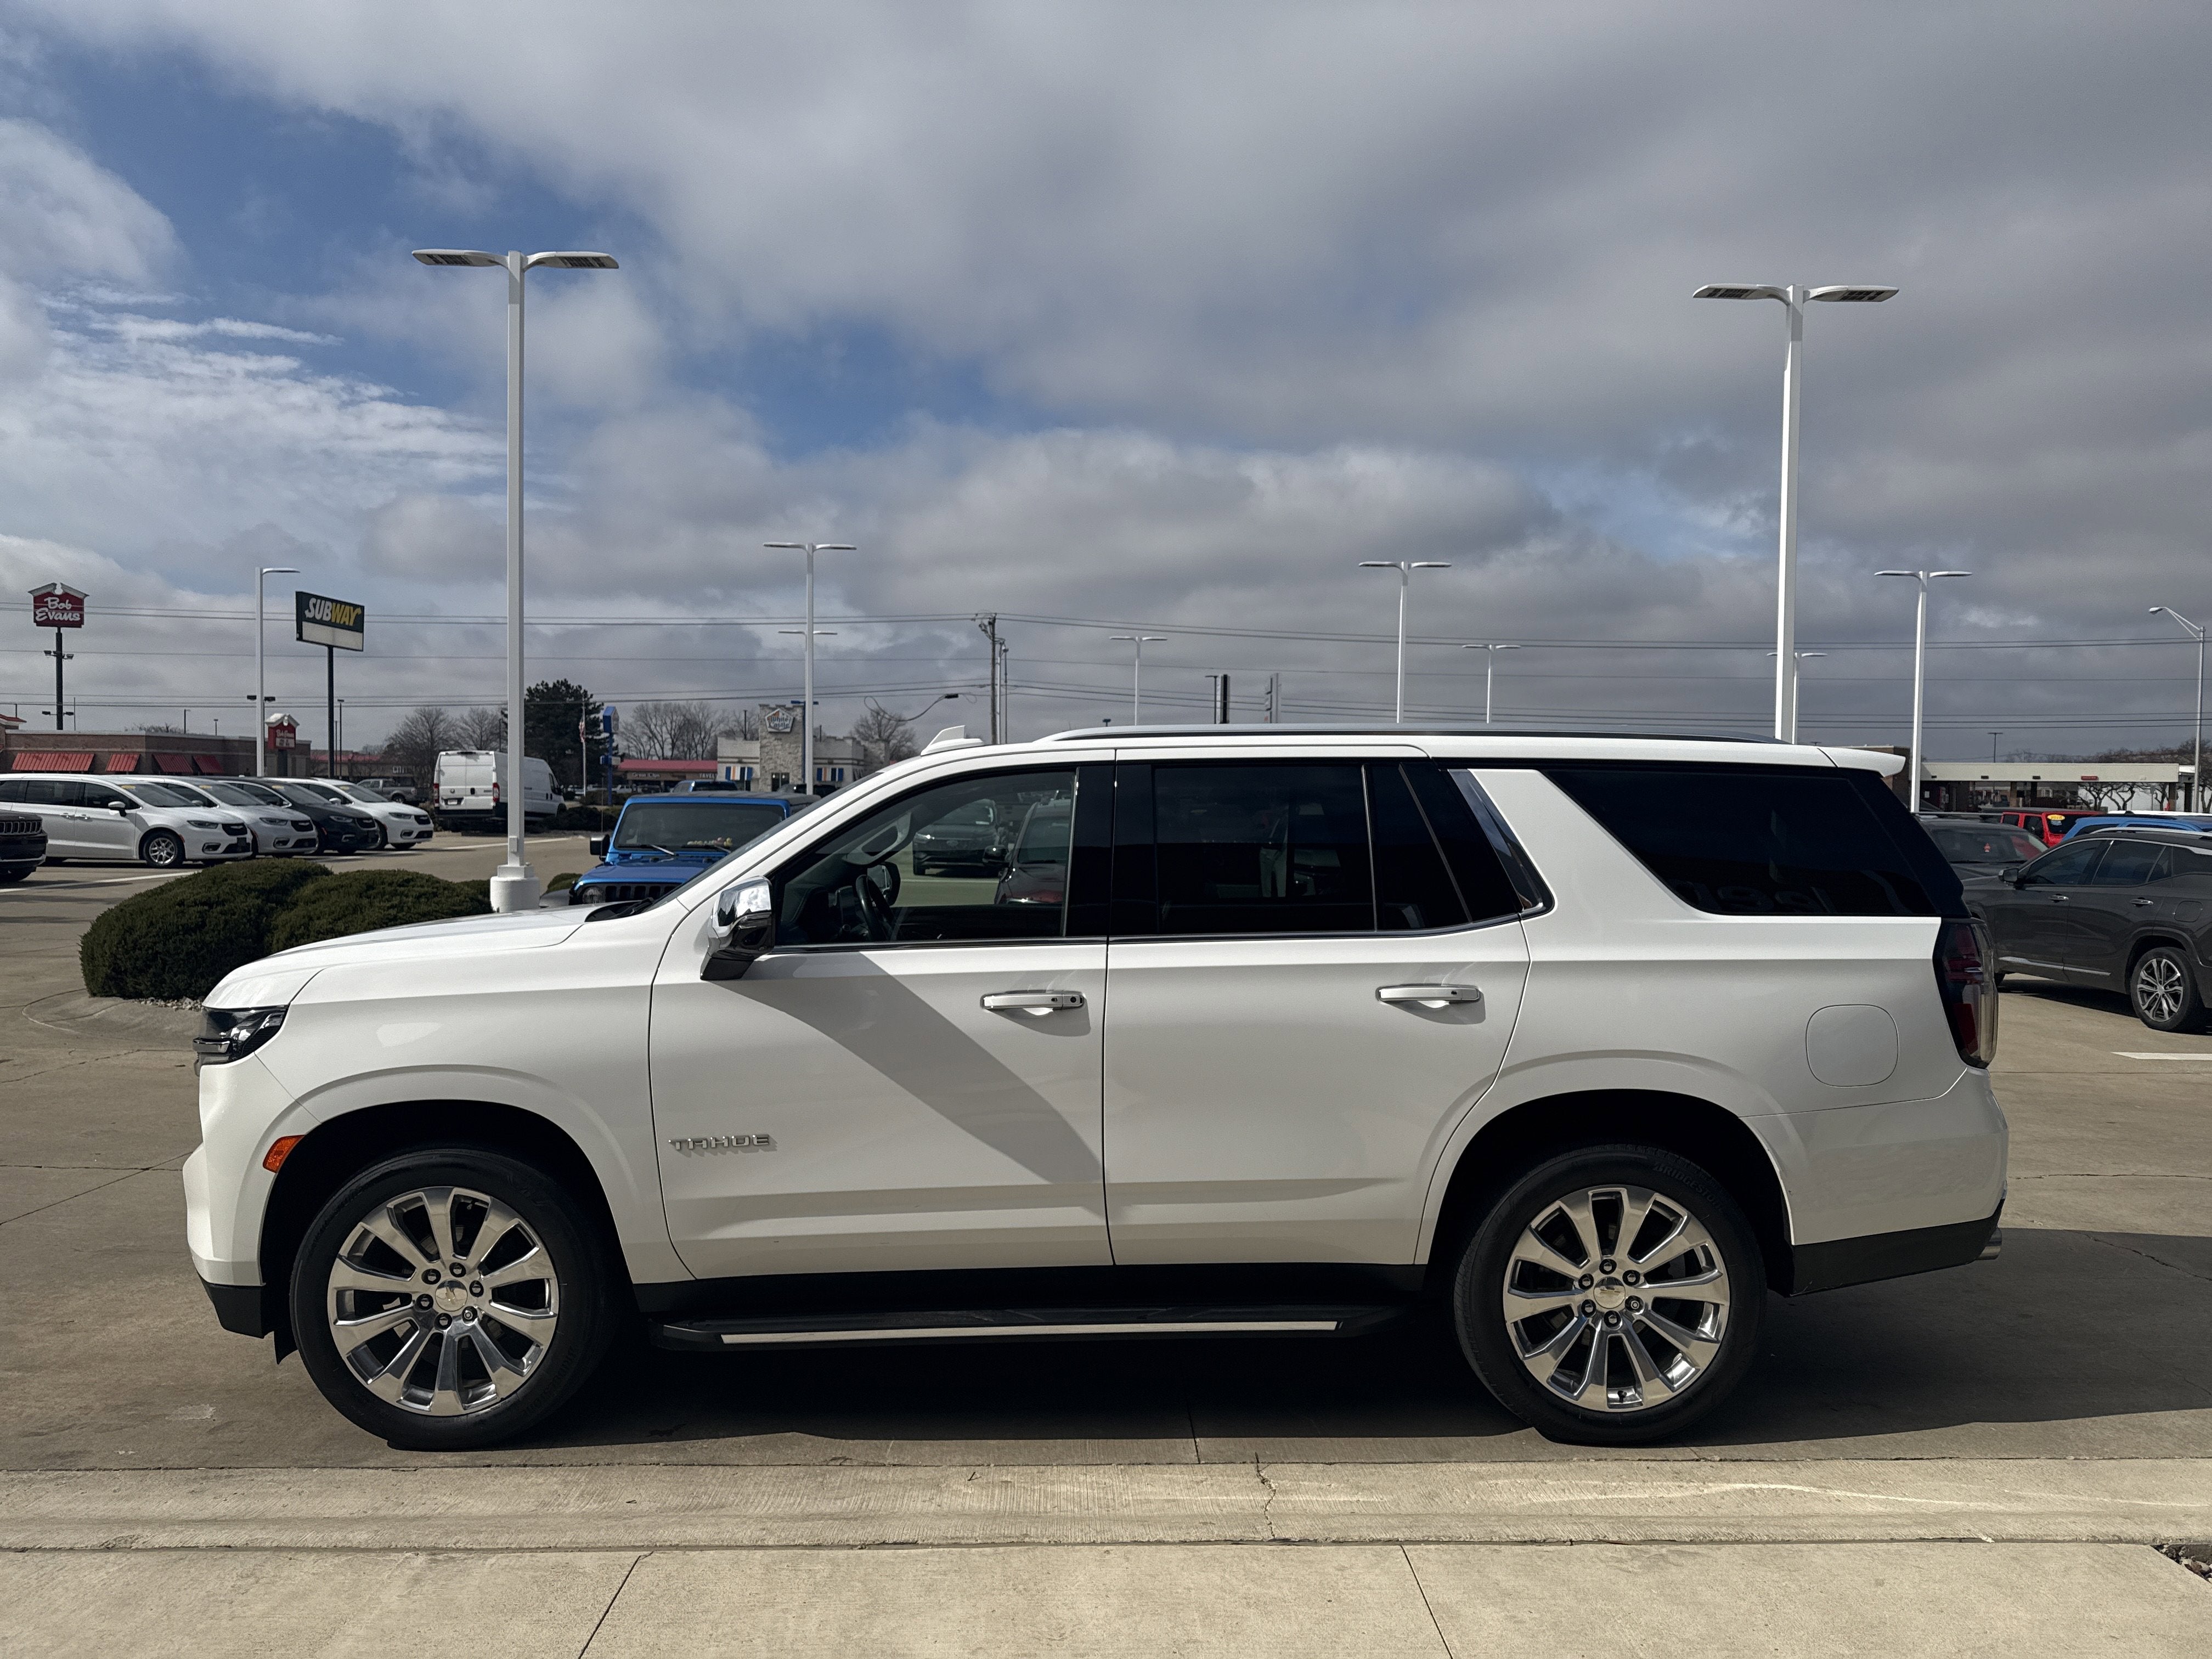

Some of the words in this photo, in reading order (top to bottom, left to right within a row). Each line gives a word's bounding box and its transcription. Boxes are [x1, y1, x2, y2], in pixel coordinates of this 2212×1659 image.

[44, 597, 72, 610] Bob
[36, 607, 81, 621] Evans
[305, 597, 362, 626] SUBWAY
[668, 1134, 769, 1150] TAHOE
